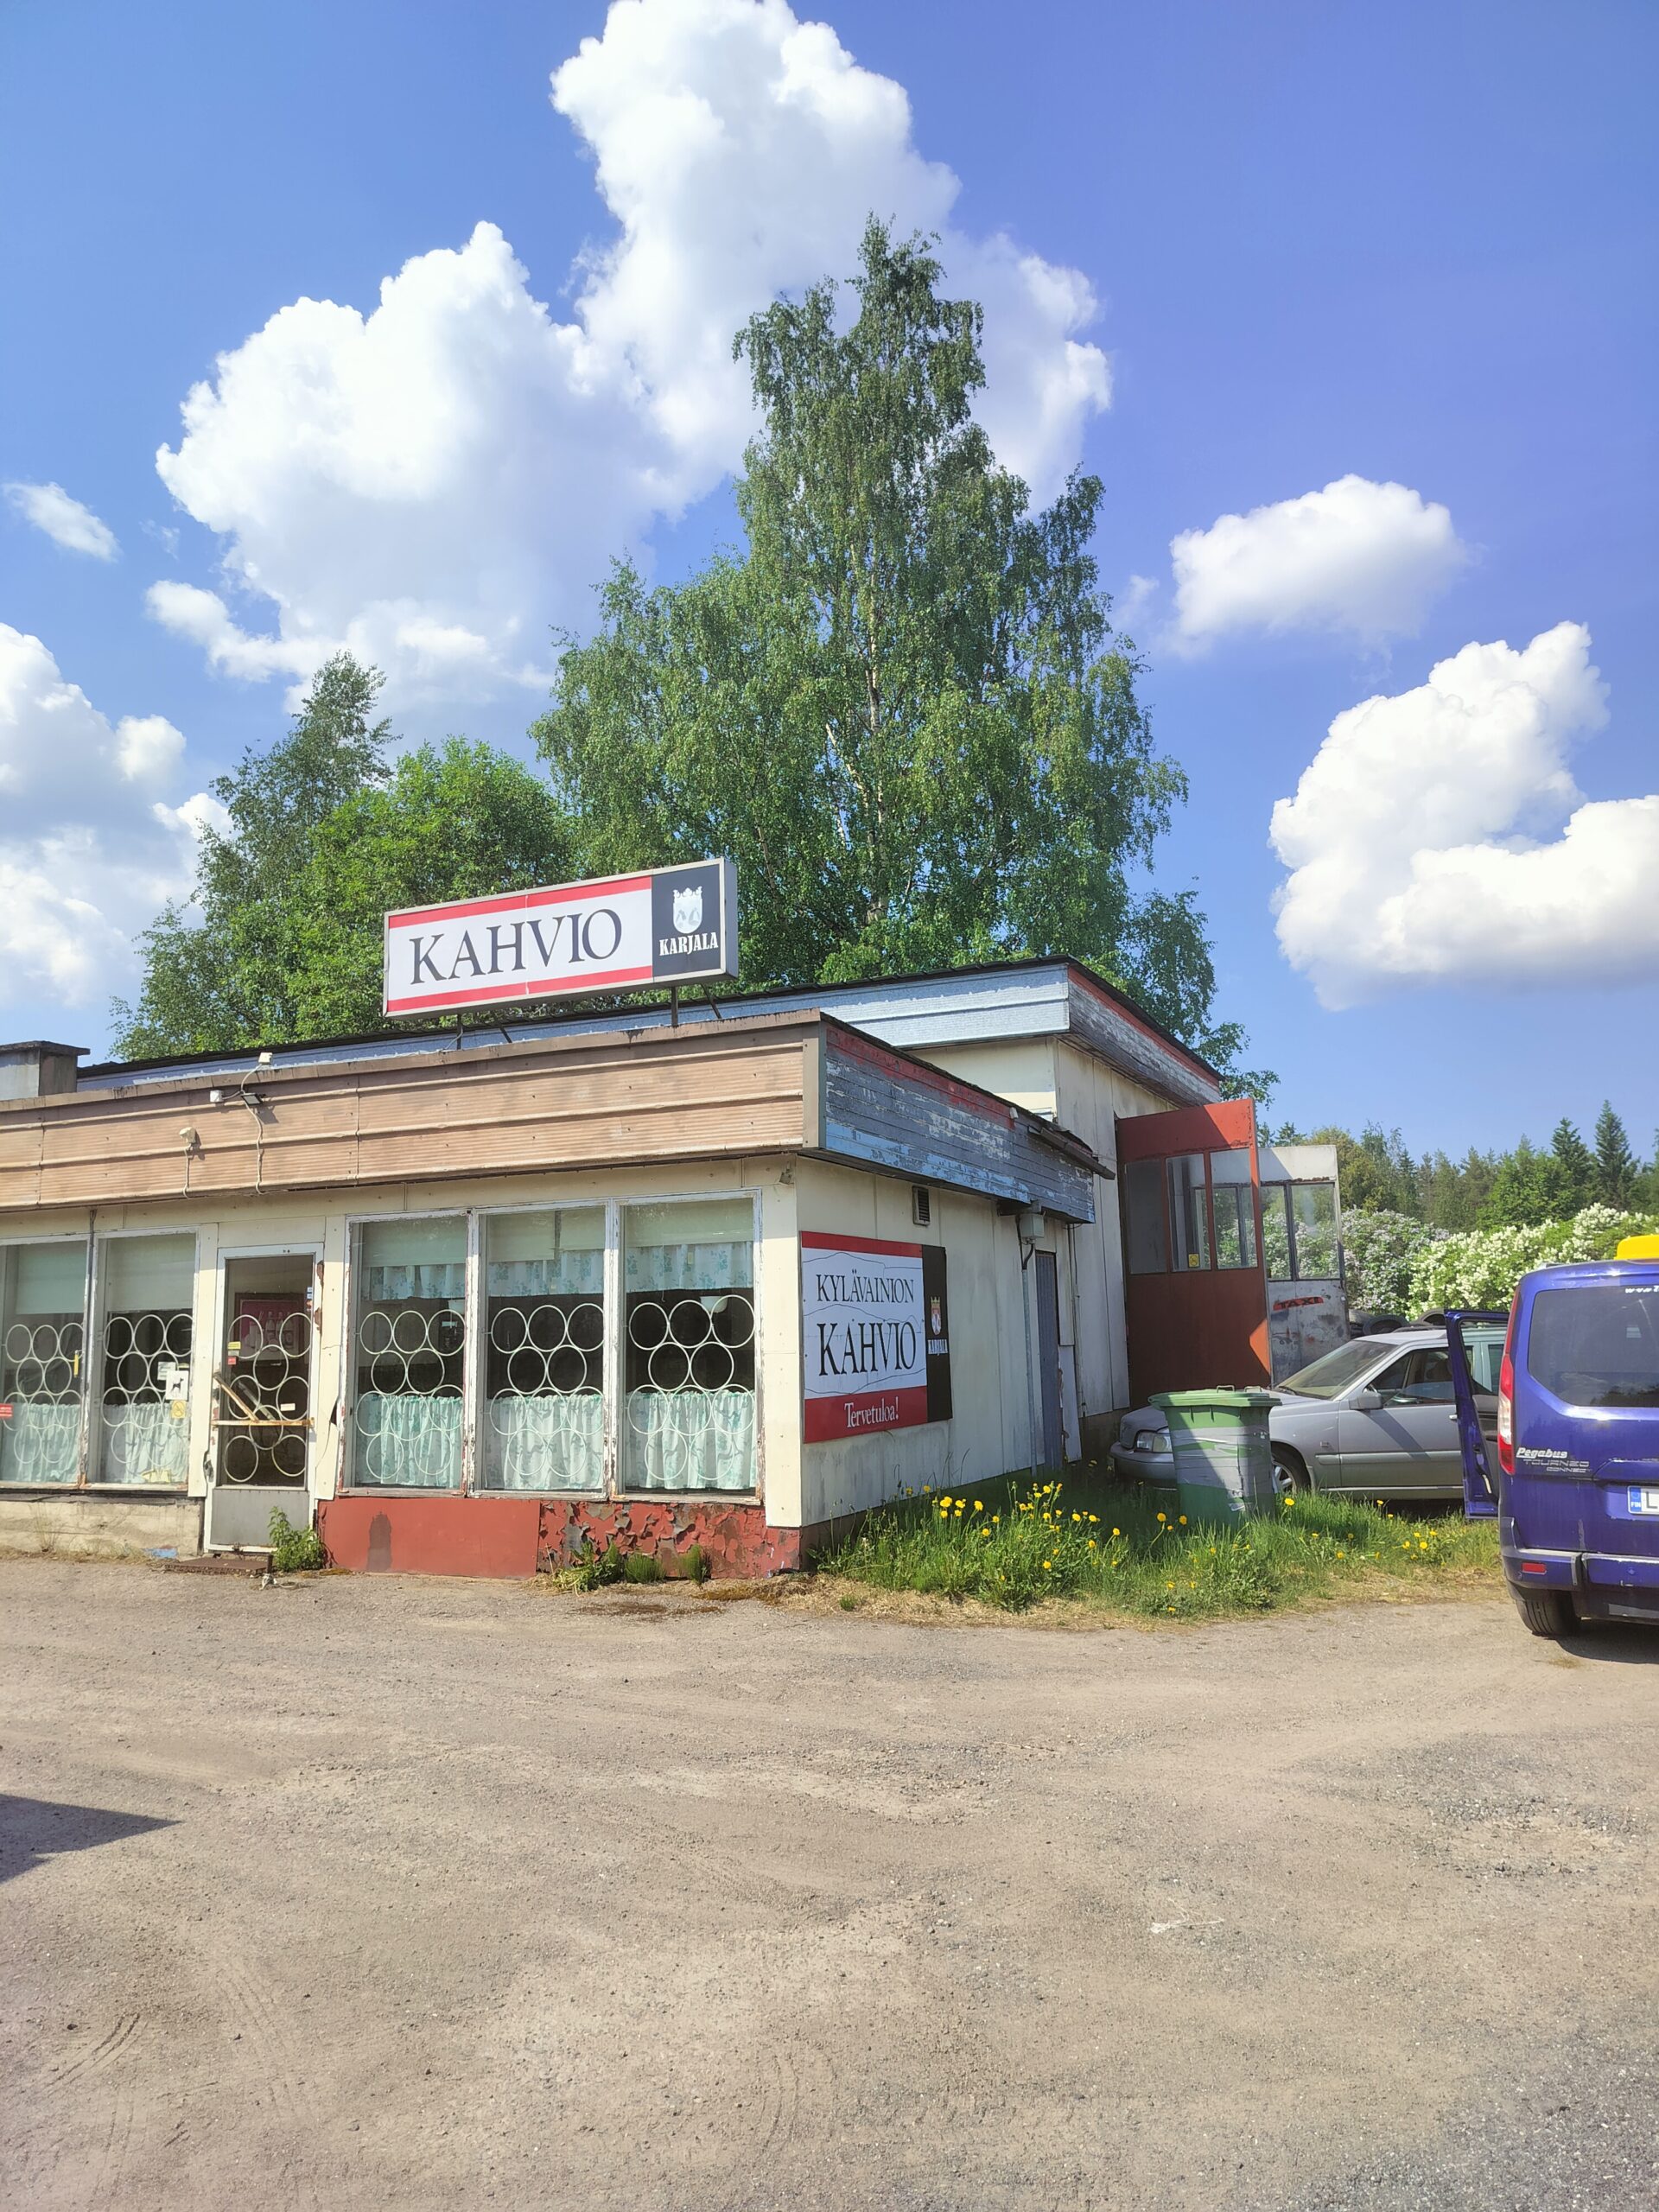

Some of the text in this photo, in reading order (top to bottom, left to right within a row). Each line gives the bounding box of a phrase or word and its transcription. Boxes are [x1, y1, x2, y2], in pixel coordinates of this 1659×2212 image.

[410, 908, 622, 985] KAHVIO
[659, 932, 719, 956] KARJALA
[816, 1268, 914, 1303] KYLÄVAINION
[1276, 1296, 1319, 1309] TAXI
[817, 1321, 916, 1376] KAHVIO
[844, 1396, 899, 1427] Tervetuloa!
[1516, 1446, 1568, 1459] Pegabus
[1523, 1459, 1590, 1467] TOURNEO
